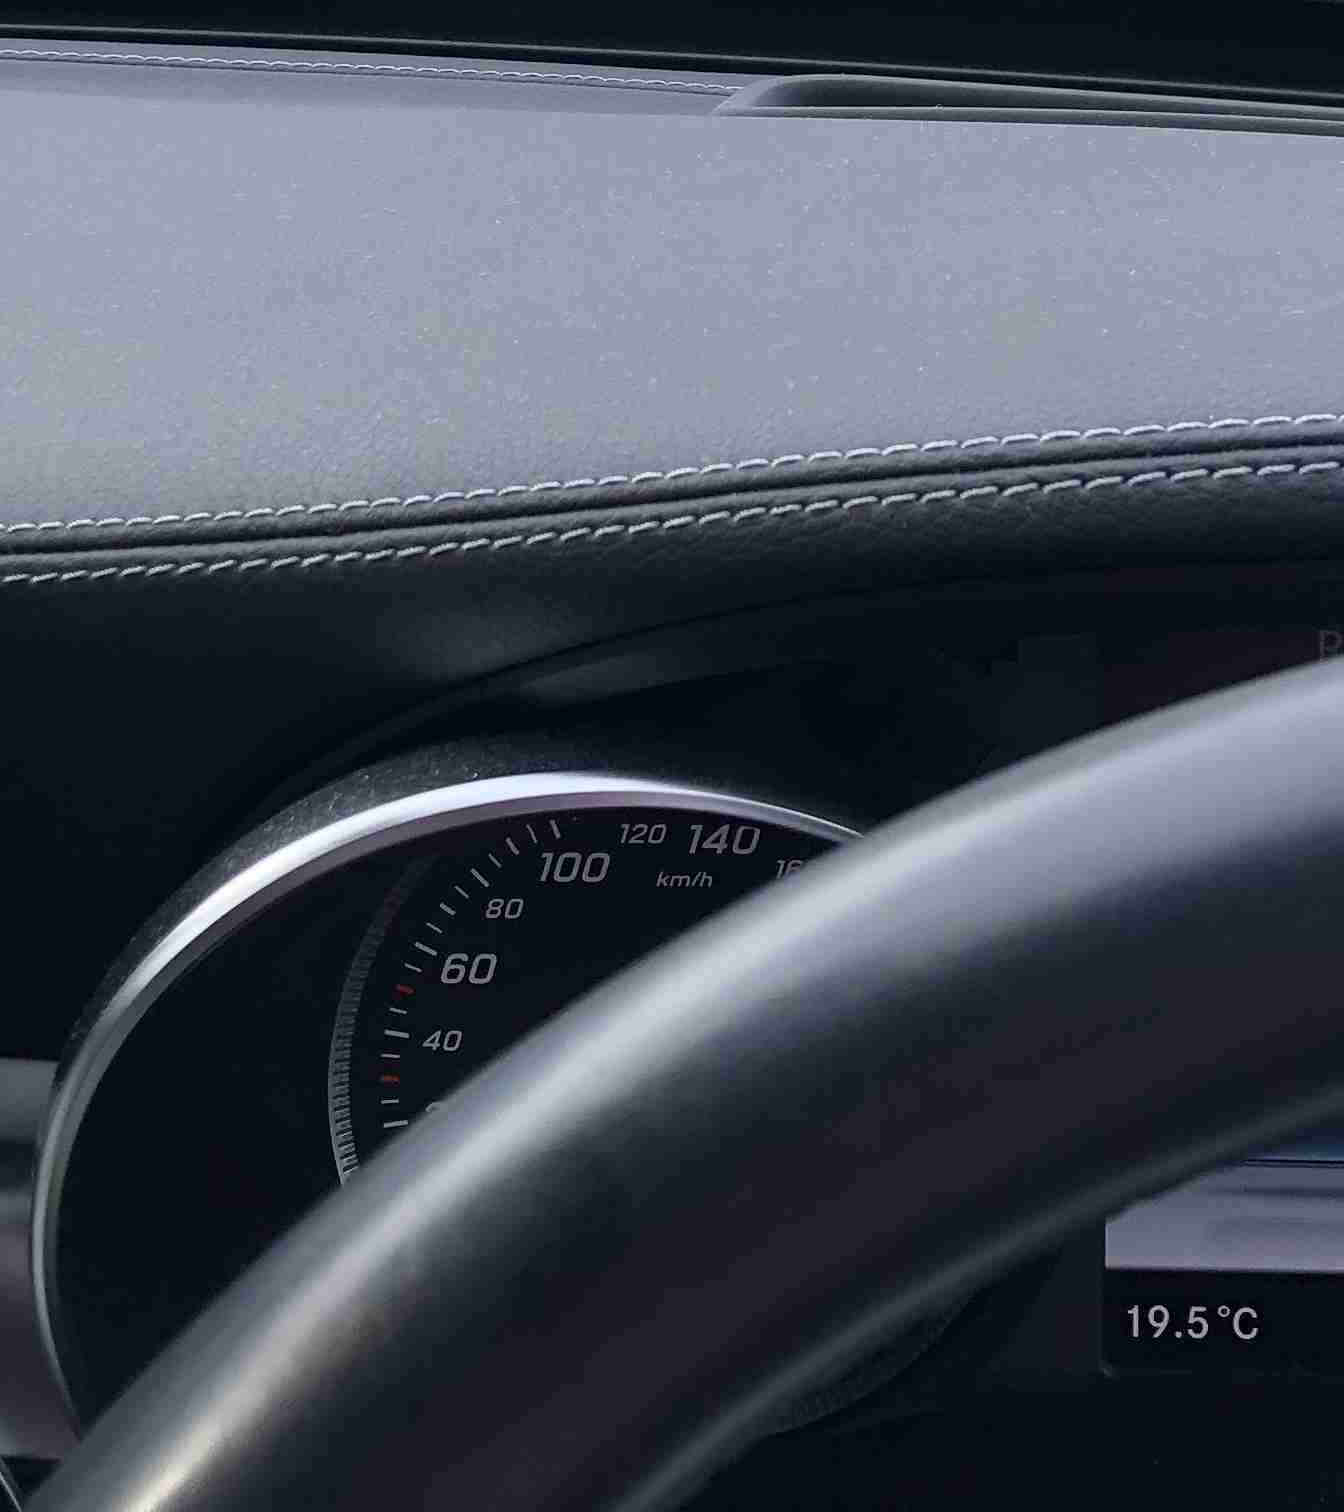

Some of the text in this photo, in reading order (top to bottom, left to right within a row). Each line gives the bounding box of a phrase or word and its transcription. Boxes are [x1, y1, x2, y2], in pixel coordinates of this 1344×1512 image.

[619, 822, 668, 845] 120
[688, 824, 761, 855] 140
[538, 851, 611, 883] 100
[776, 858, 804, 880] 16
[655, 872, 714, 889] km/h
[484, 898, 525, 920] 80
[440, 952, 498, 985] 60
[422, 1030, 463, 1052] 40
[1126, 1305, 1259, 1340] 19.5°C
